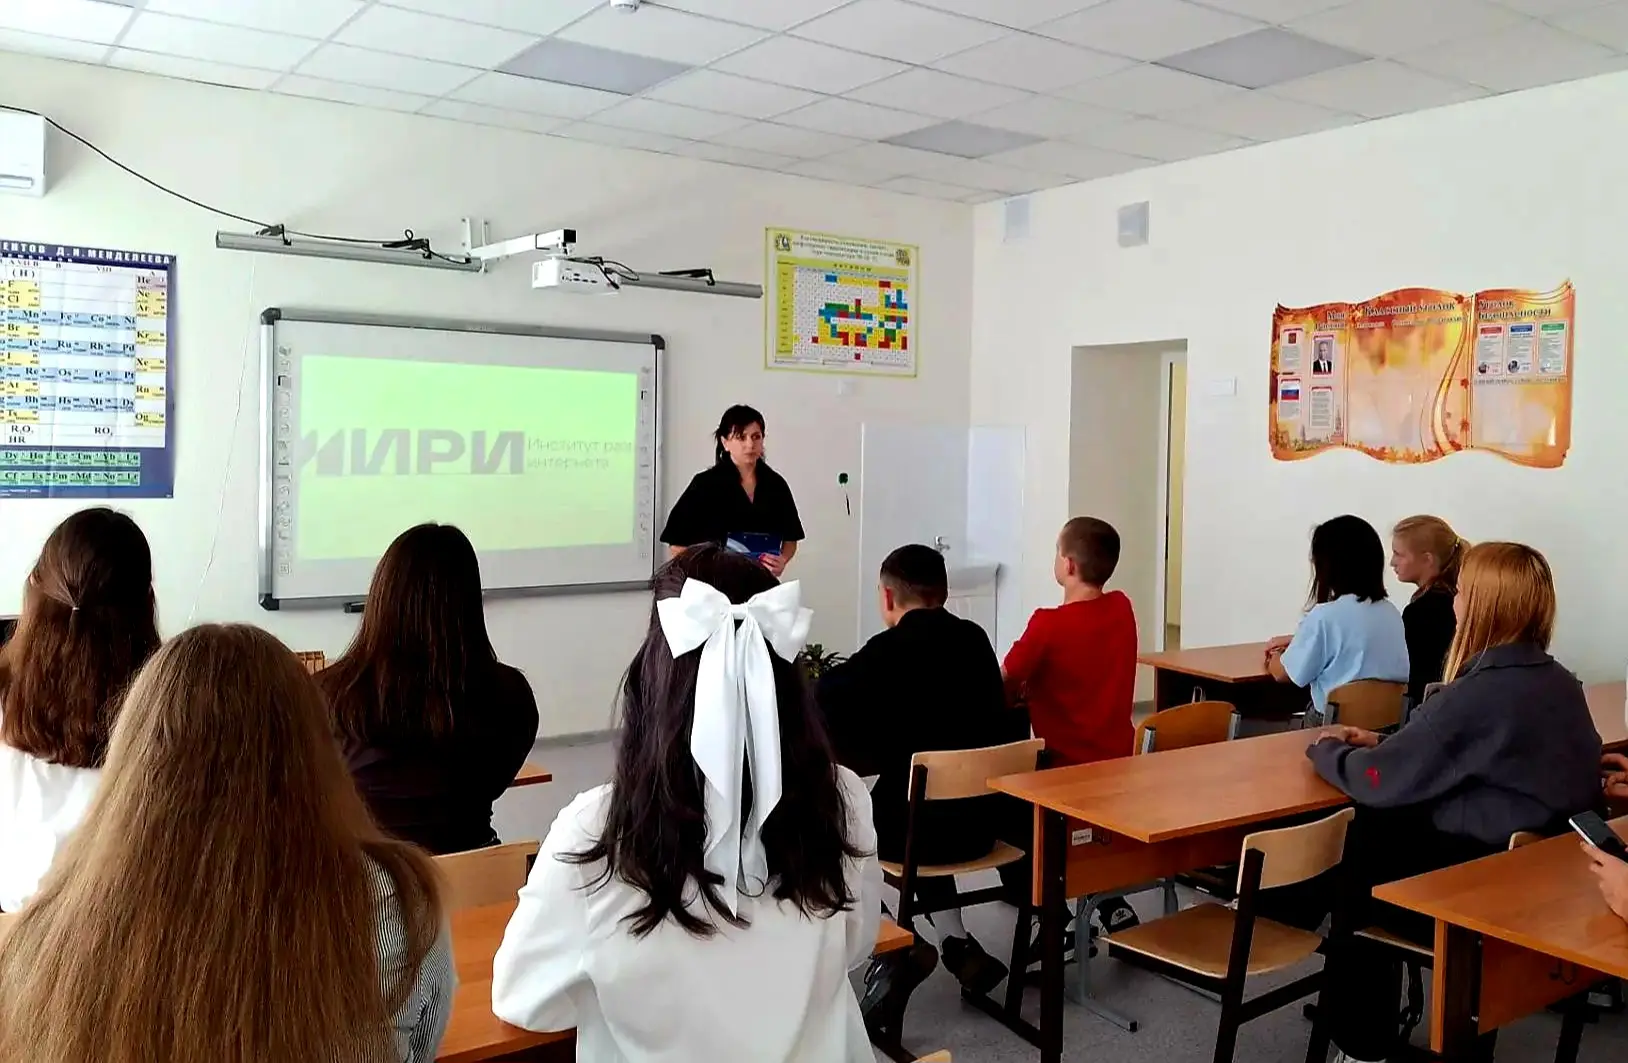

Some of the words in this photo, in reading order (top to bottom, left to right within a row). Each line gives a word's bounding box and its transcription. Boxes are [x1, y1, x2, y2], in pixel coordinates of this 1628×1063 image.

[22, 310, 39, 318] Mn
[8, 323, 20, 331] Br
[90, 341, 104, 350] Rh
[123, 343, 135, 351] Pd
